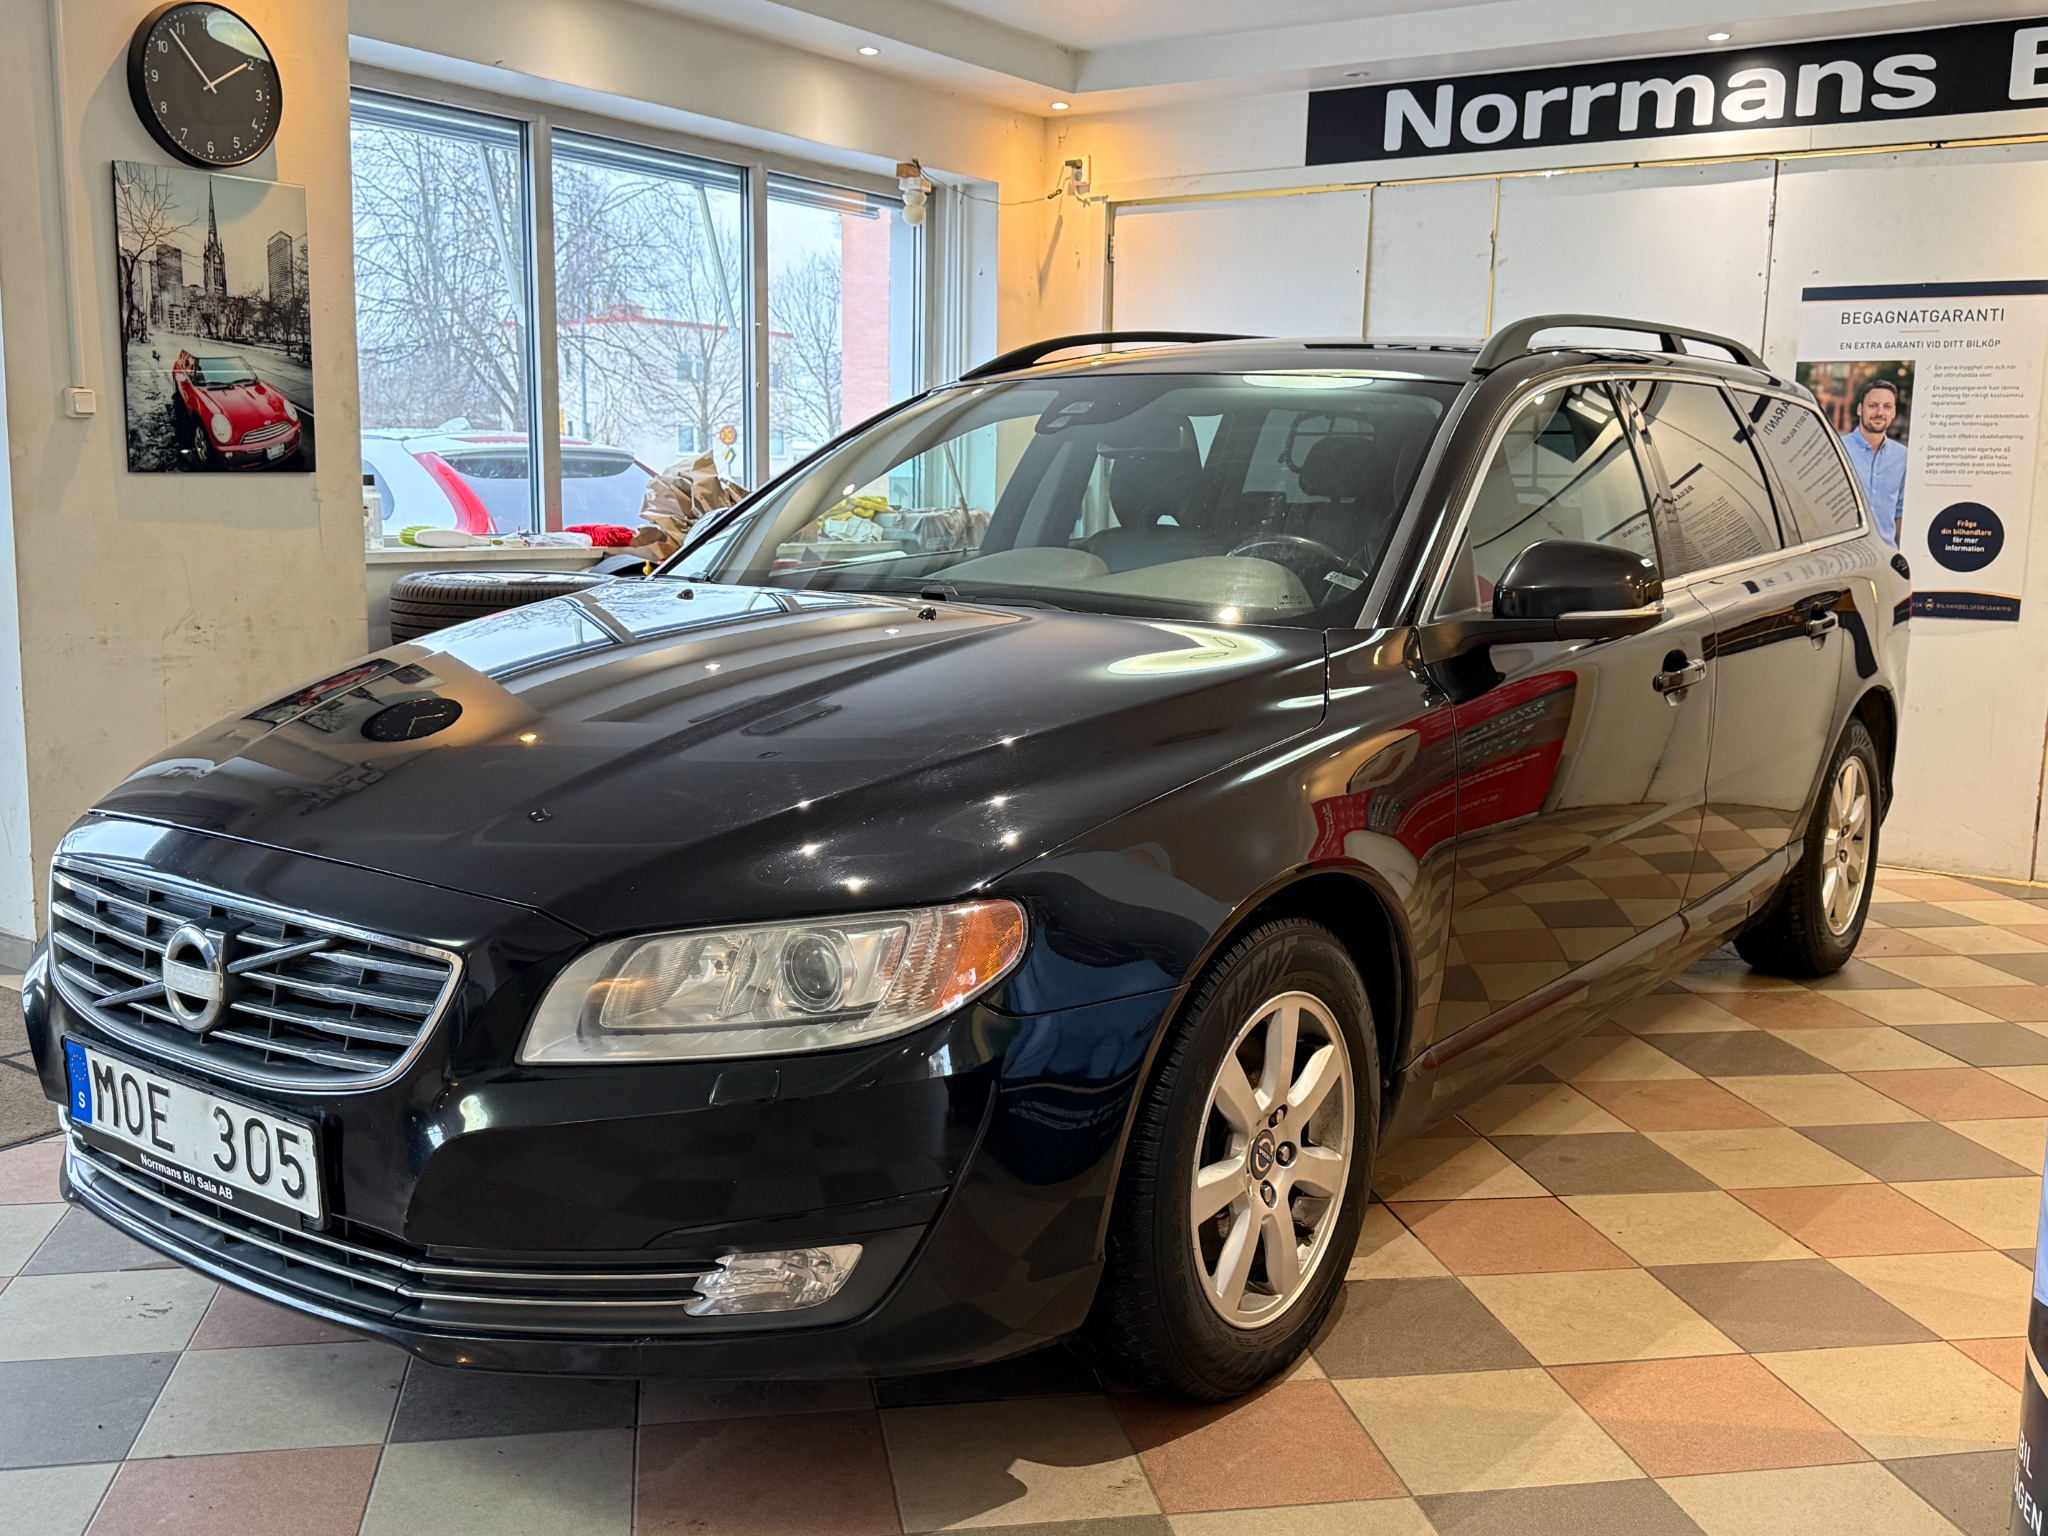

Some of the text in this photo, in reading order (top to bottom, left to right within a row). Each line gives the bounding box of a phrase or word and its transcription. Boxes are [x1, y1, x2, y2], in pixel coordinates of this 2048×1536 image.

[175, 22, 186, 36] 11
[157, 40, 169, 53] 10
[247, 58, 255, 71] 2
[151, 70, 159, 82] 9
[255, 89, 263, 102] 3
[160, 101, 168, 114] 8
[1383, 54, 1937, 151] Norrmans
[251, 117, 259, 130] 4
[180, 127, 188, 140] 7
[207, 141, 215, 154] 6
[233, 136, 240, 149] 5
[1841, 308, 2005, 325] BEGAGNATGARANTI
[1839, 338, 2001, 350] EN EXTRA GARANTI VID DITT BILKÖP
[1957, 520, 1977, 528] Fråga
[1953, 528, 1992, 536] bilhandlare
[1945, 544, 1985, 552] information
[78, 1091, 86, 1110] S
[92, 1059, 306, 1200] MOE 305
[140, 1152, 233, 1200] Norrmans Bil Sala AB
[2018, 1429, 2033, 1480] BIL
